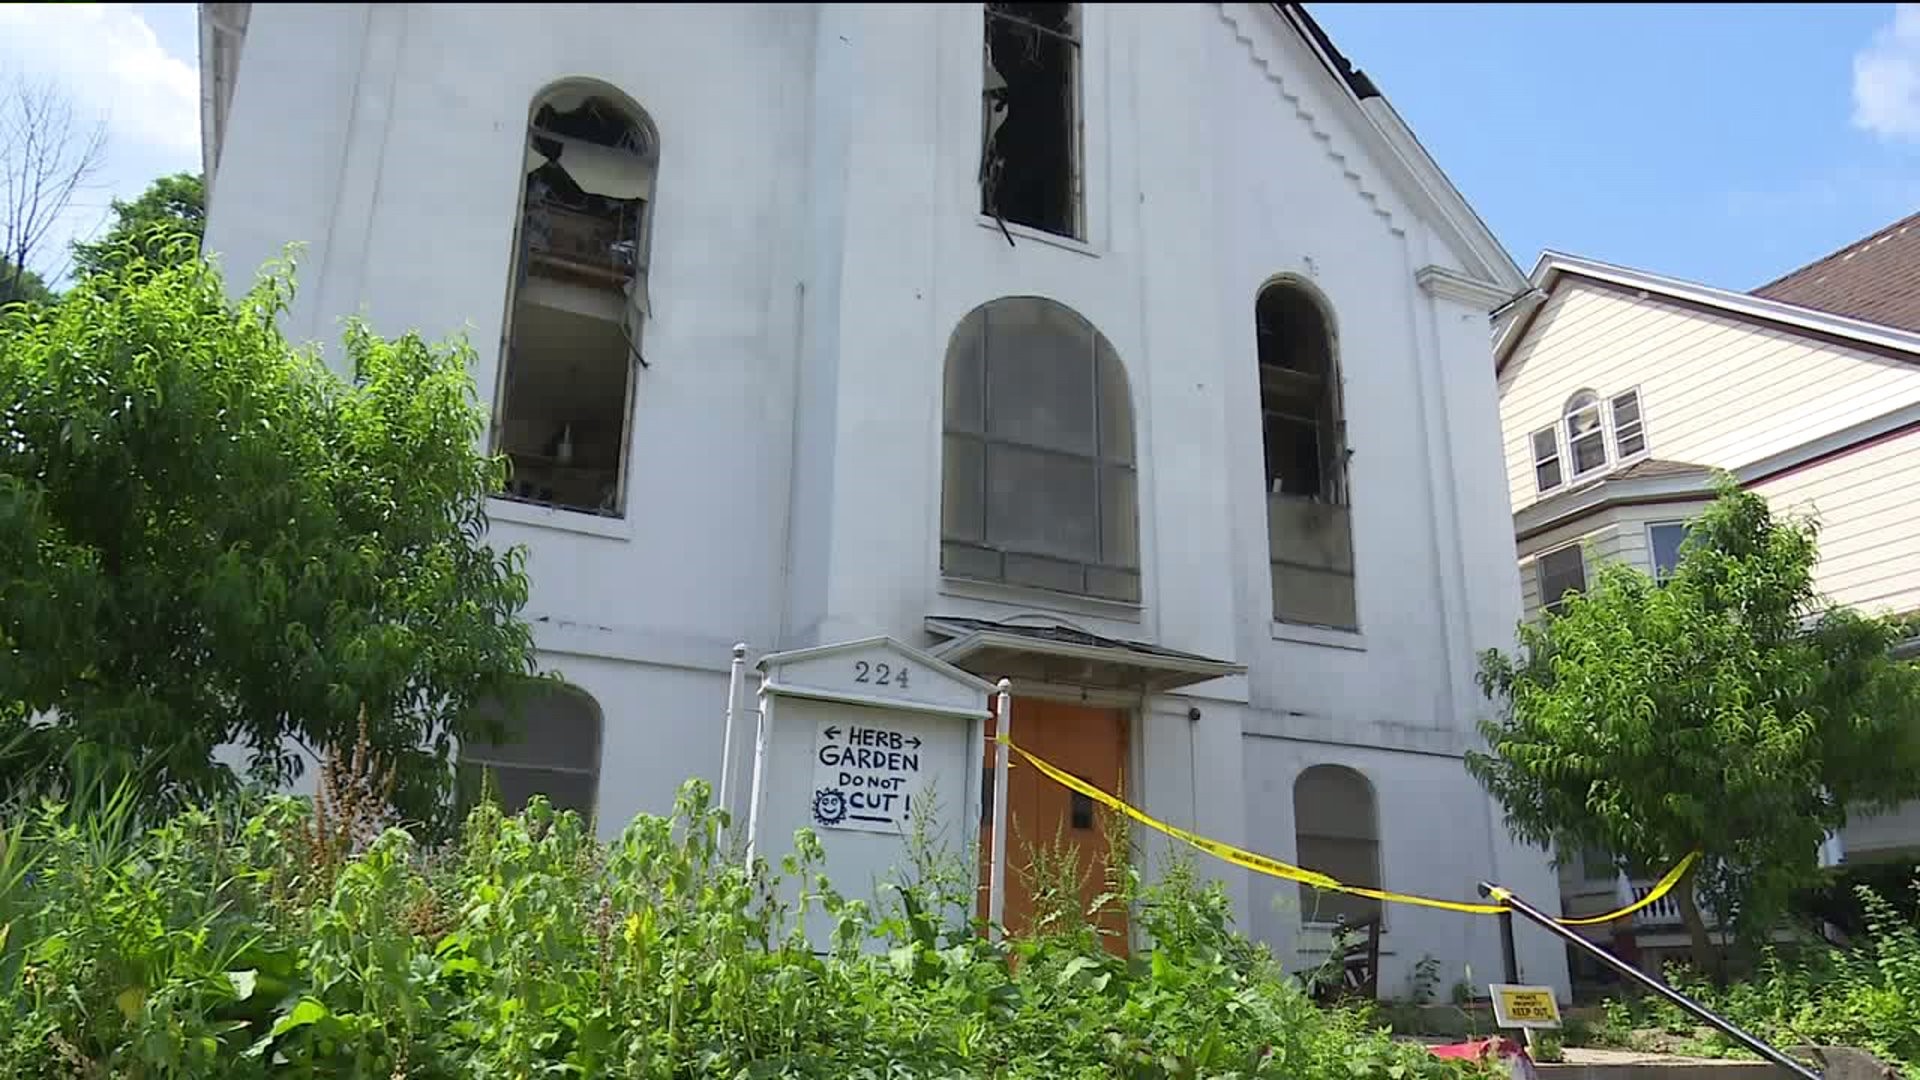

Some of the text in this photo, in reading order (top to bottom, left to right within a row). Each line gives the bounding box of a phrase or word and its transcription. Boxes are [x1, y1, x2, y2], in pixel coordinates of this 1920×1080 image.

[855, 660, 909, 688] 224
[849, 726, 903, 750] HERB
[819, 744, 919, 772] GARDEN
[839, 772, 906, 791] DO NOT
